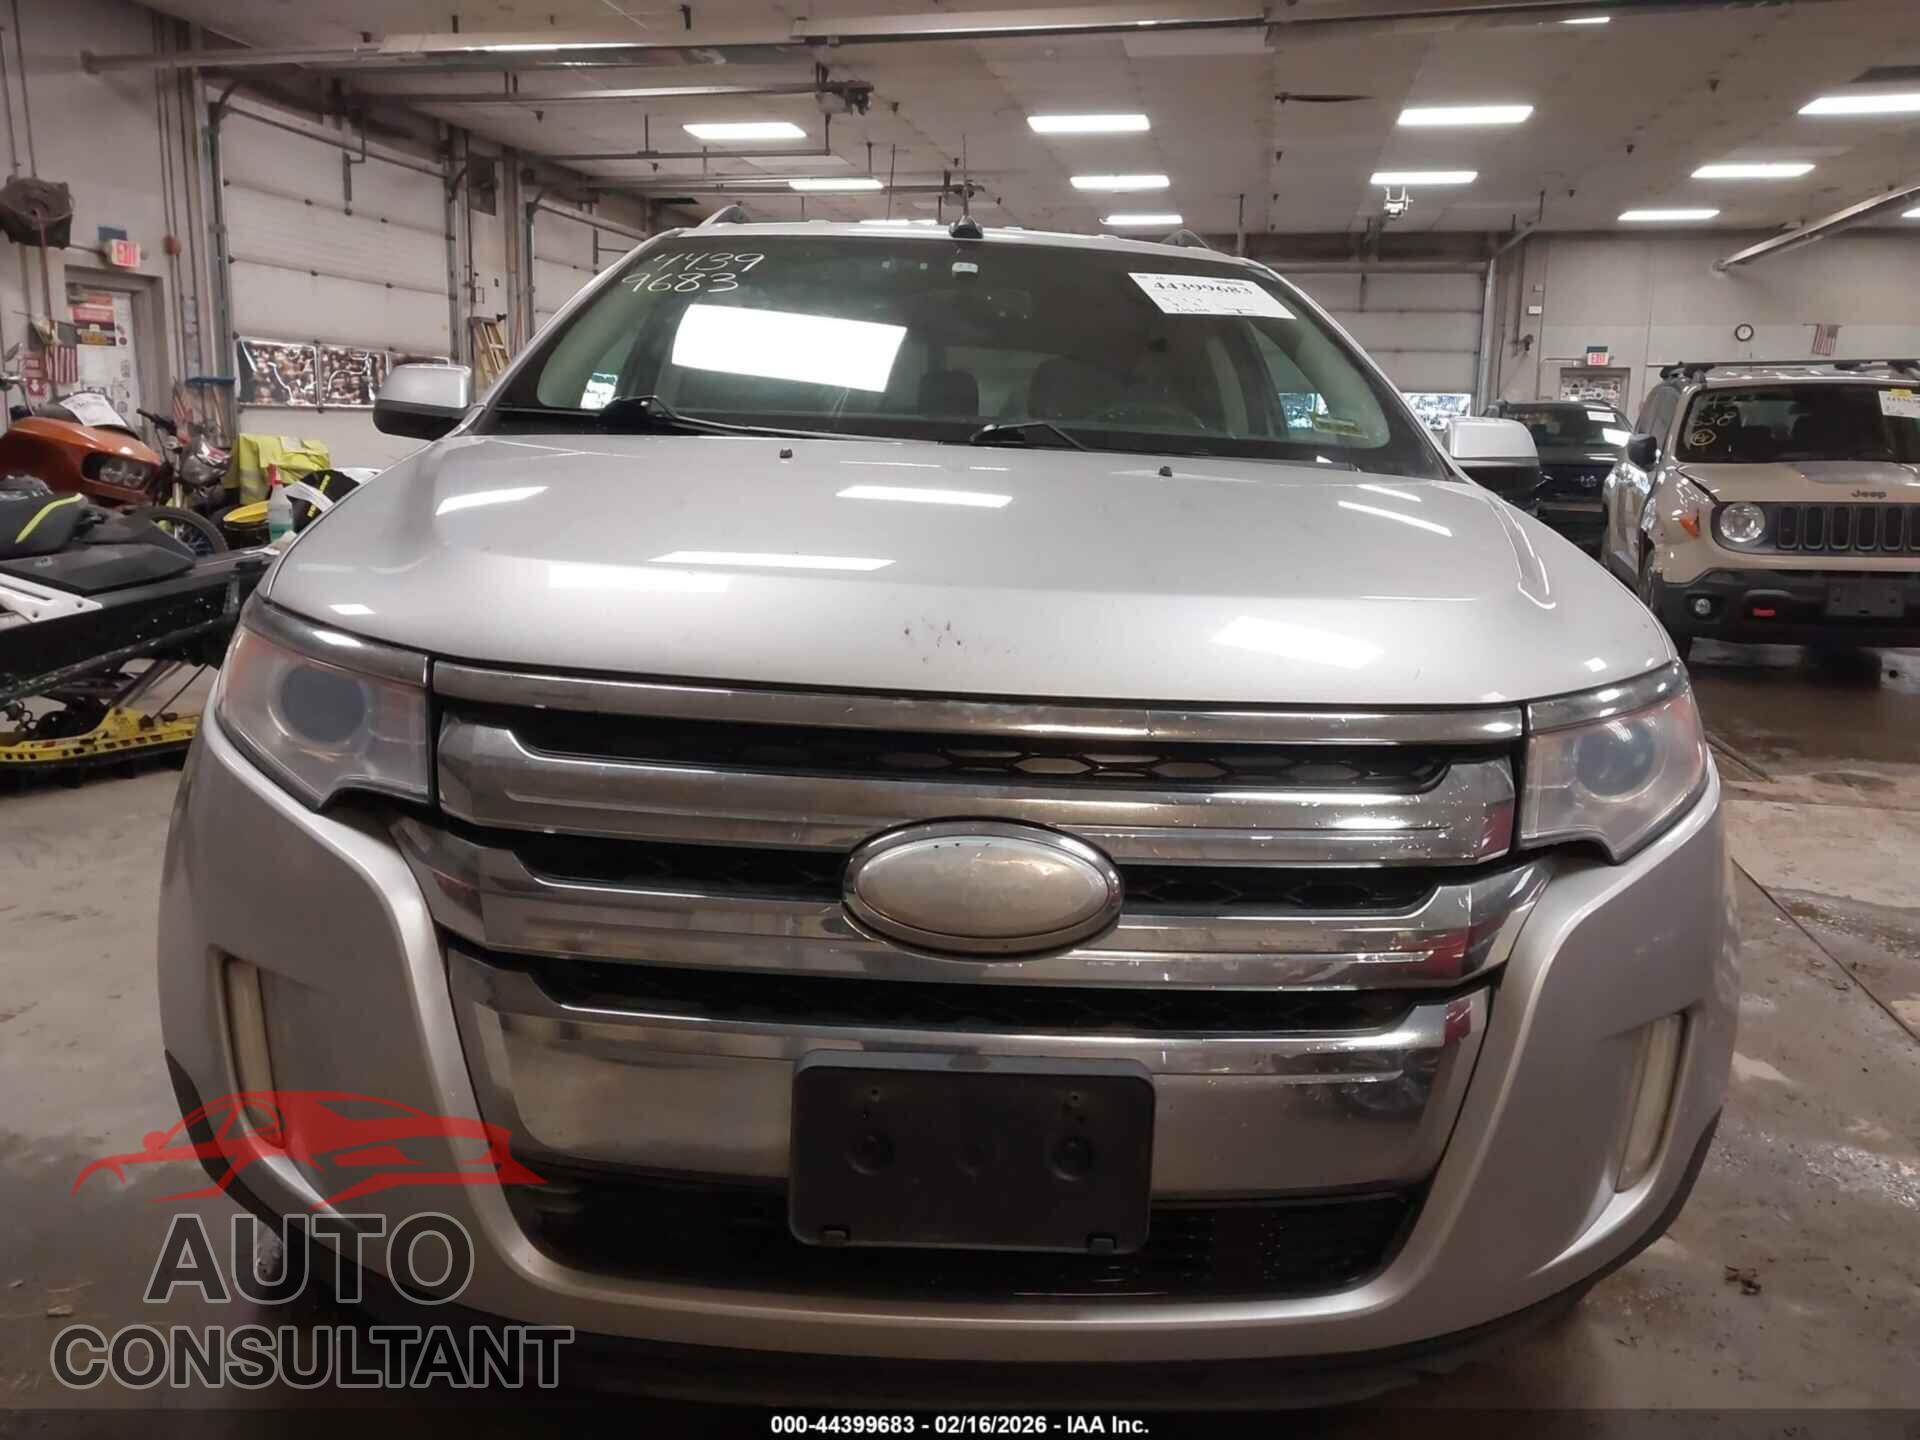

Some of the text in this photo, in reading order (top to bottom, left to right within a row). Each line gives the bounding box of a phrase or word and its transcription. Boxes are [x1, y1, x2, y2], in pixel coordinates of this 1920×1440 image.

[653, 252, 765, 272] 4439
[621, 272, 739, 292] 9683
[1851, 489, 1888, 500] Jeep
